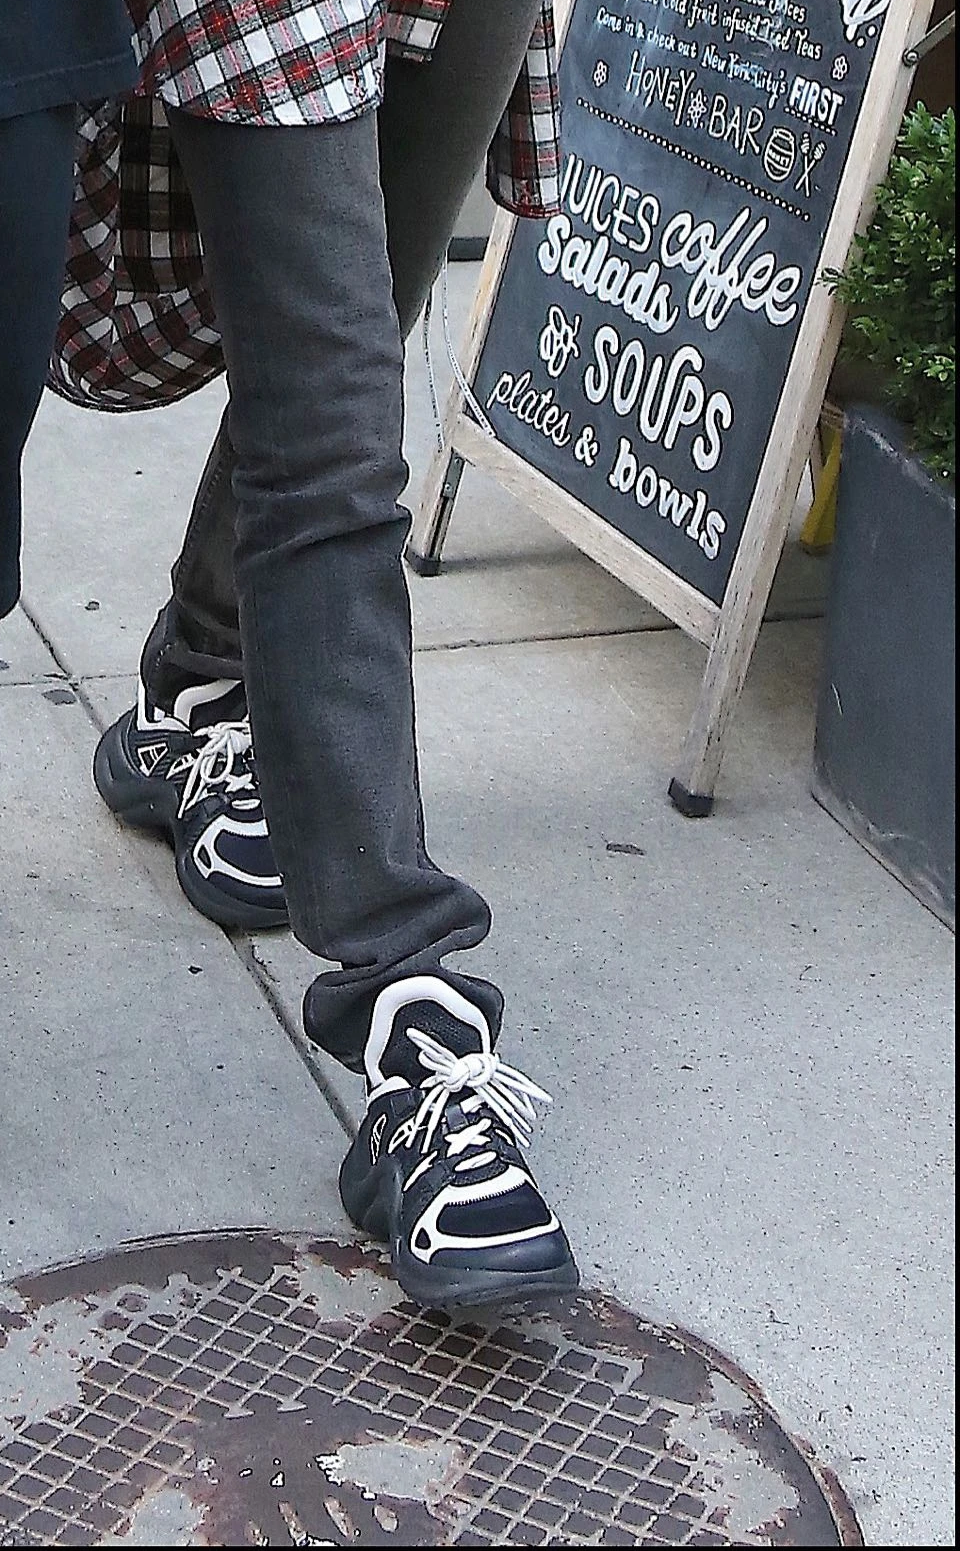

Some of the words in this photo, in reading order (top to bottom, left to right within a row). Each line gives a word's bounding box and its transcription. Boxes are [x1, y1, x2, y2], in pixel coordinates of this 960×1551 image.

[597, 7, 622, 32] Come
[625, 16, 634, 37] in
[647, 25, 676, 51] check
[678, 42, 697, 58] out
[701, 44, 727, 73] New
[789, 76, 845, 126] FIRST
[722, 8, 760, 41] infused
[795, 29, 822, 59] Teas
[709, 95, 765, 155] BAR
[538, 214, 679, 334] Salads
[661, 206, 801, 331] coffee
[584, 326, 733, 471] SOUPS
[487, 371, 571, 447] plates
[574, 428, 598, 466] &
[609, 438, 727, 559] bowls
